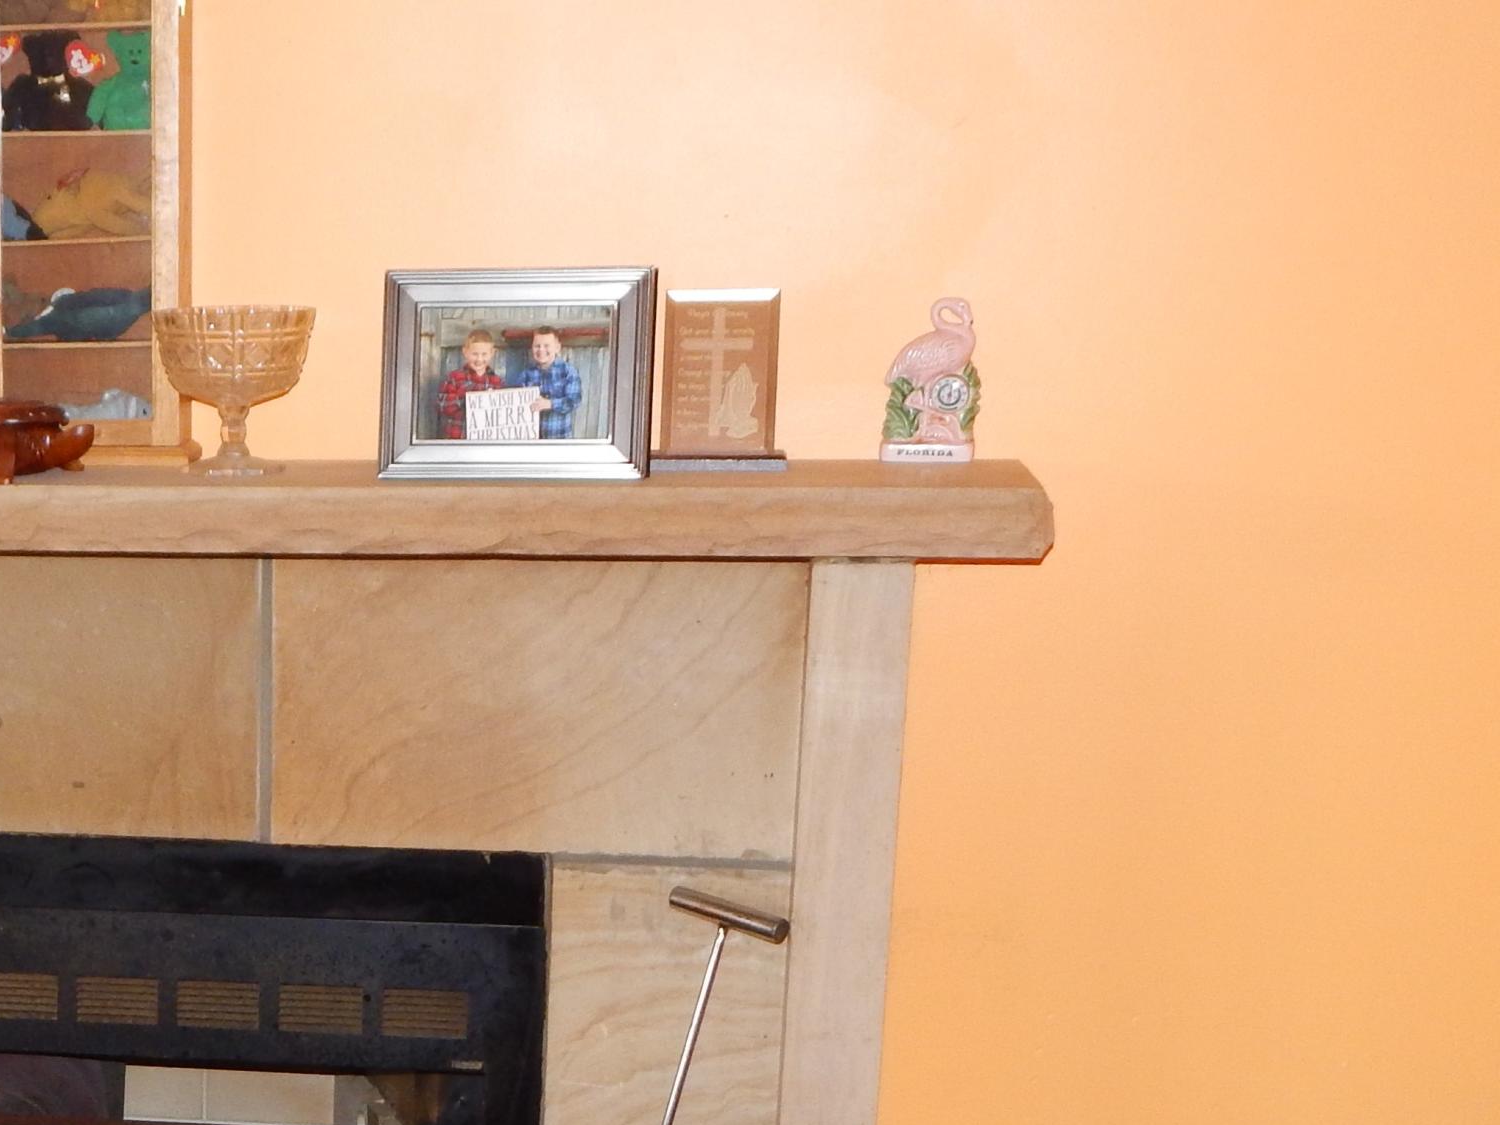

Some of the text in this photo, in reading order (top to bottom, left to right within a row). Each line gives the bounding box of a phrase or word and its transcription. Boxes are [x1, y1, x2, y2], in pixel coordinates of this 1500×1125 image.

[468, 395, 483, 409] WE
[489, 392, 514, 407] WISH
[469, 411, 478, 431] A
[896, 448, 954, 457] FLORIDA
